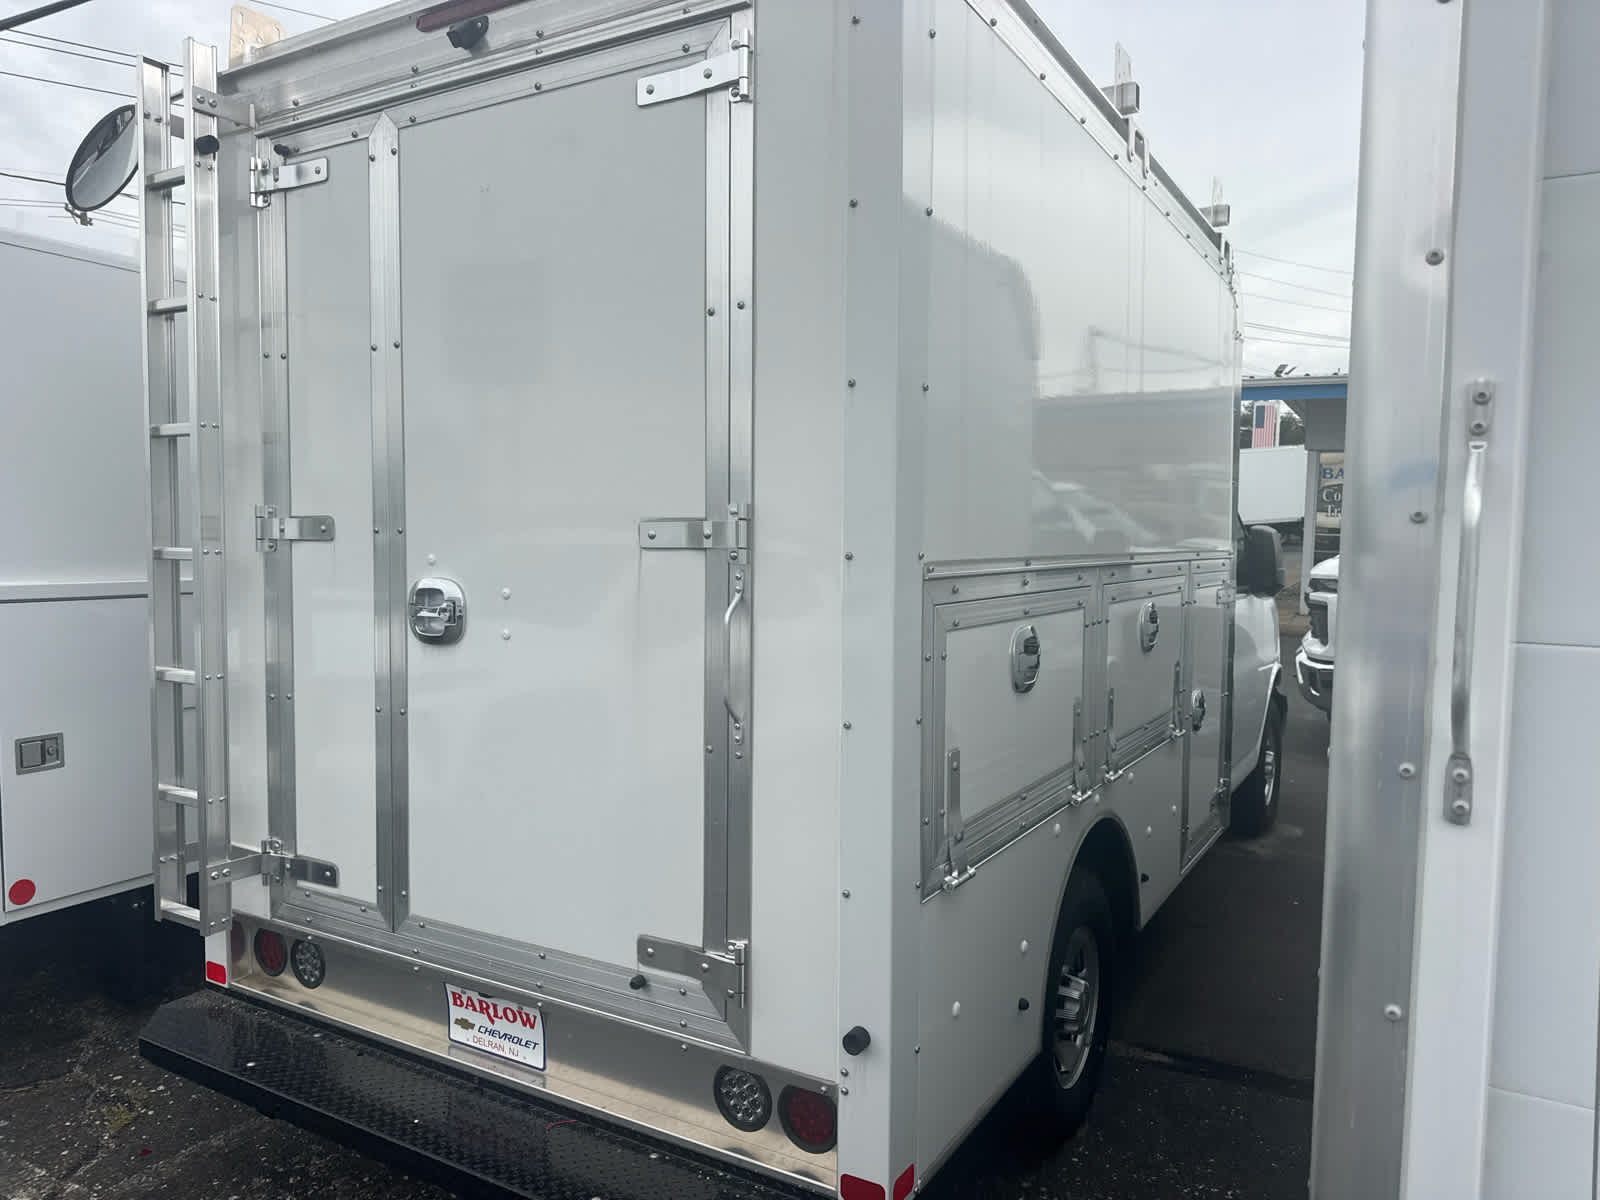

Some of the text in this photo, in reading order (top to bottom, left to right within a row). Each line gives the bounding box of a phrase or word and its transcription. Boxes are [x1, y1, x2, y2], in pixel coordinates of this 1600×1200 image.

[450, 990, 537, 1030] BARLOW
[472, 1035, 519, 1057] DELRAN, NJ
[477, 1025, 539, 1050] CHEVROLET
